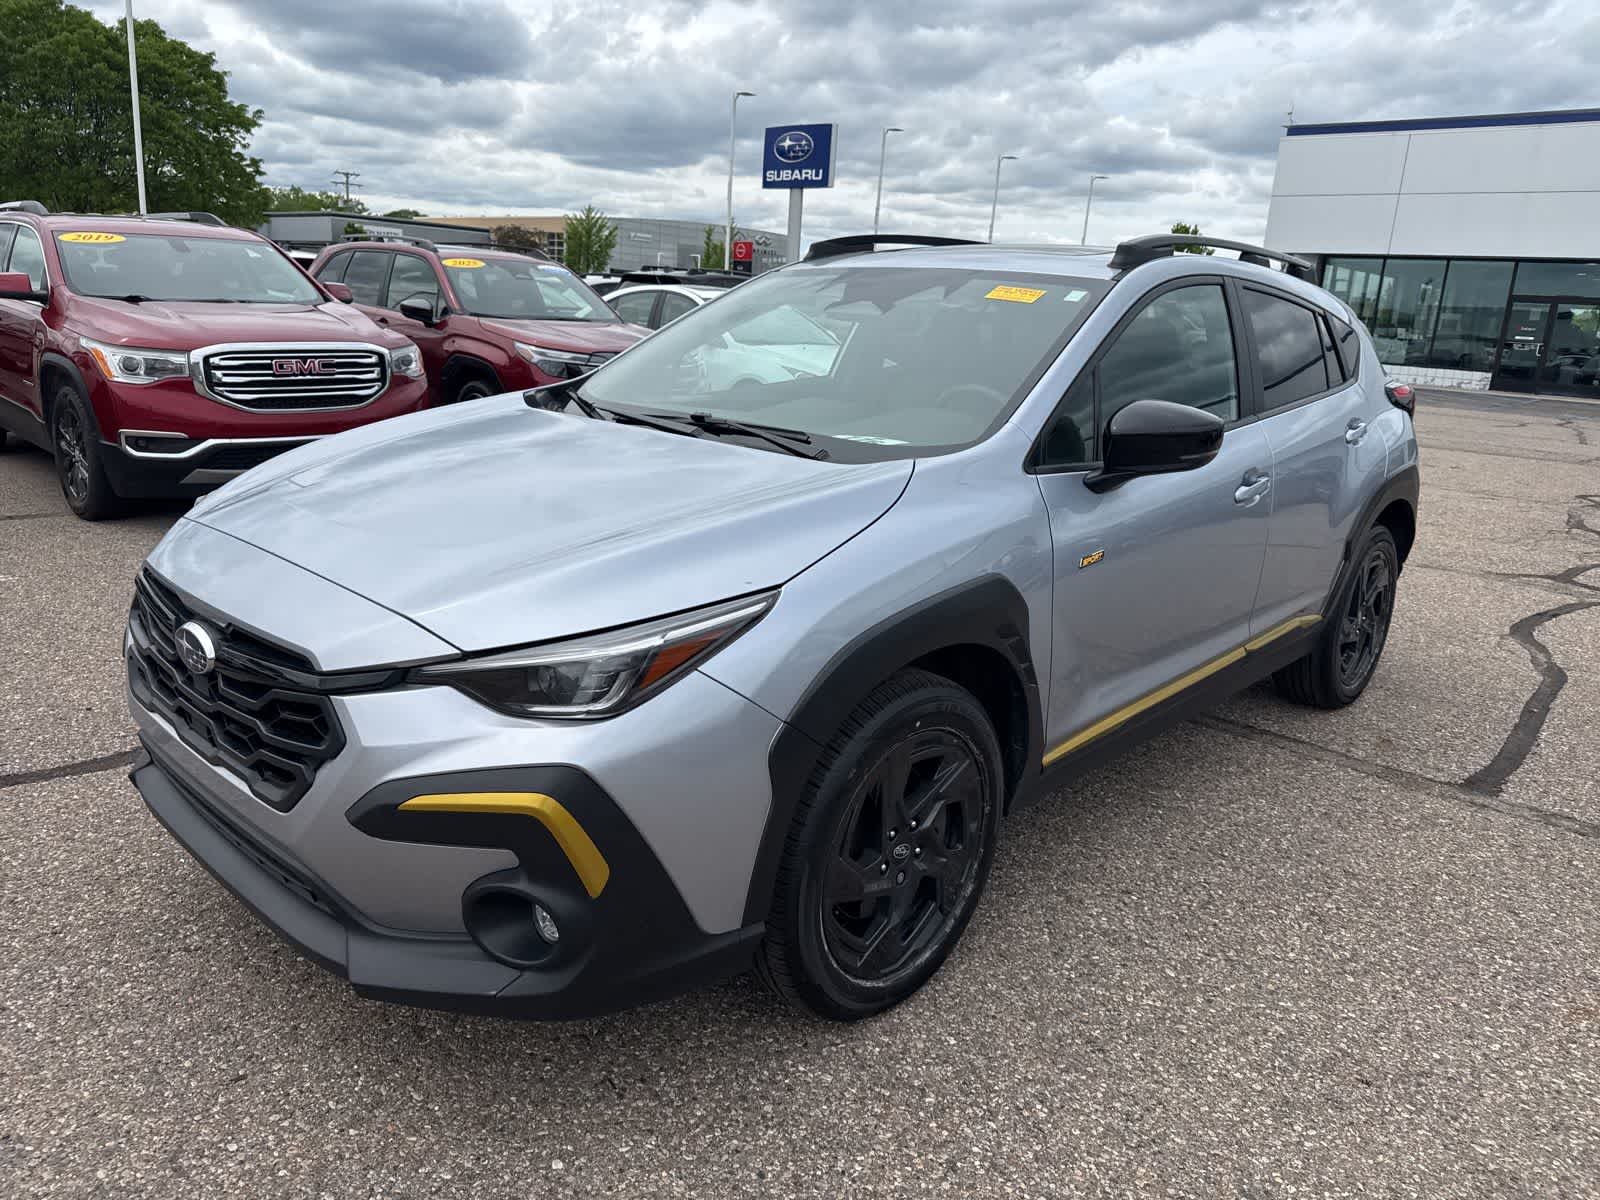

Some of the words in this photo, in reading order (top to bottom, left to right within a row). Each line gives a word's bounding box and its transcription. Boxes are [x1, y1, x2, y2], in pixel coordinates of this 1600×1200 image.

[766, 169, 823, 182] SUBARU
[71, 233, 115, 242] 2019
[272, 358, 337, 375] GMC
